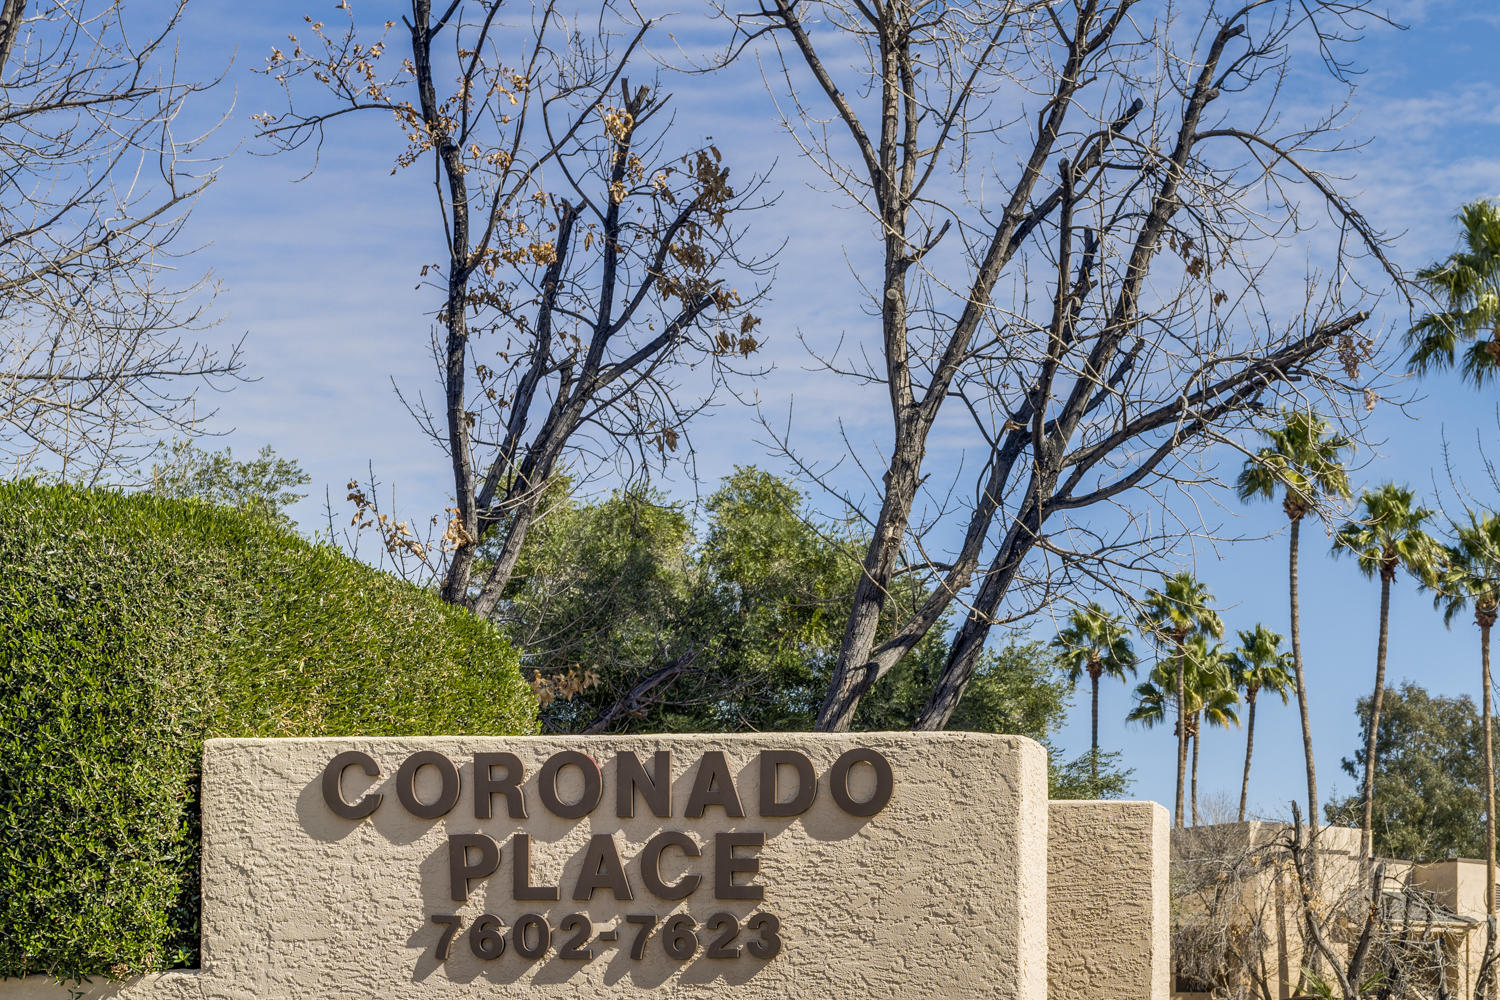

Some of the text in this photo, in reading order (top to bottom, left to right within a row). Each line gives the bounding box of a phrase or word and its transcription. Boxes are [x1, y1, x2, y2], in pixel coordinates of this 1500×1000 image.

[321, 747, 895, 821] CORONADO
[447, 830, 768, 902] PLACE
[430, 911, 781, 961] 7602-7623
